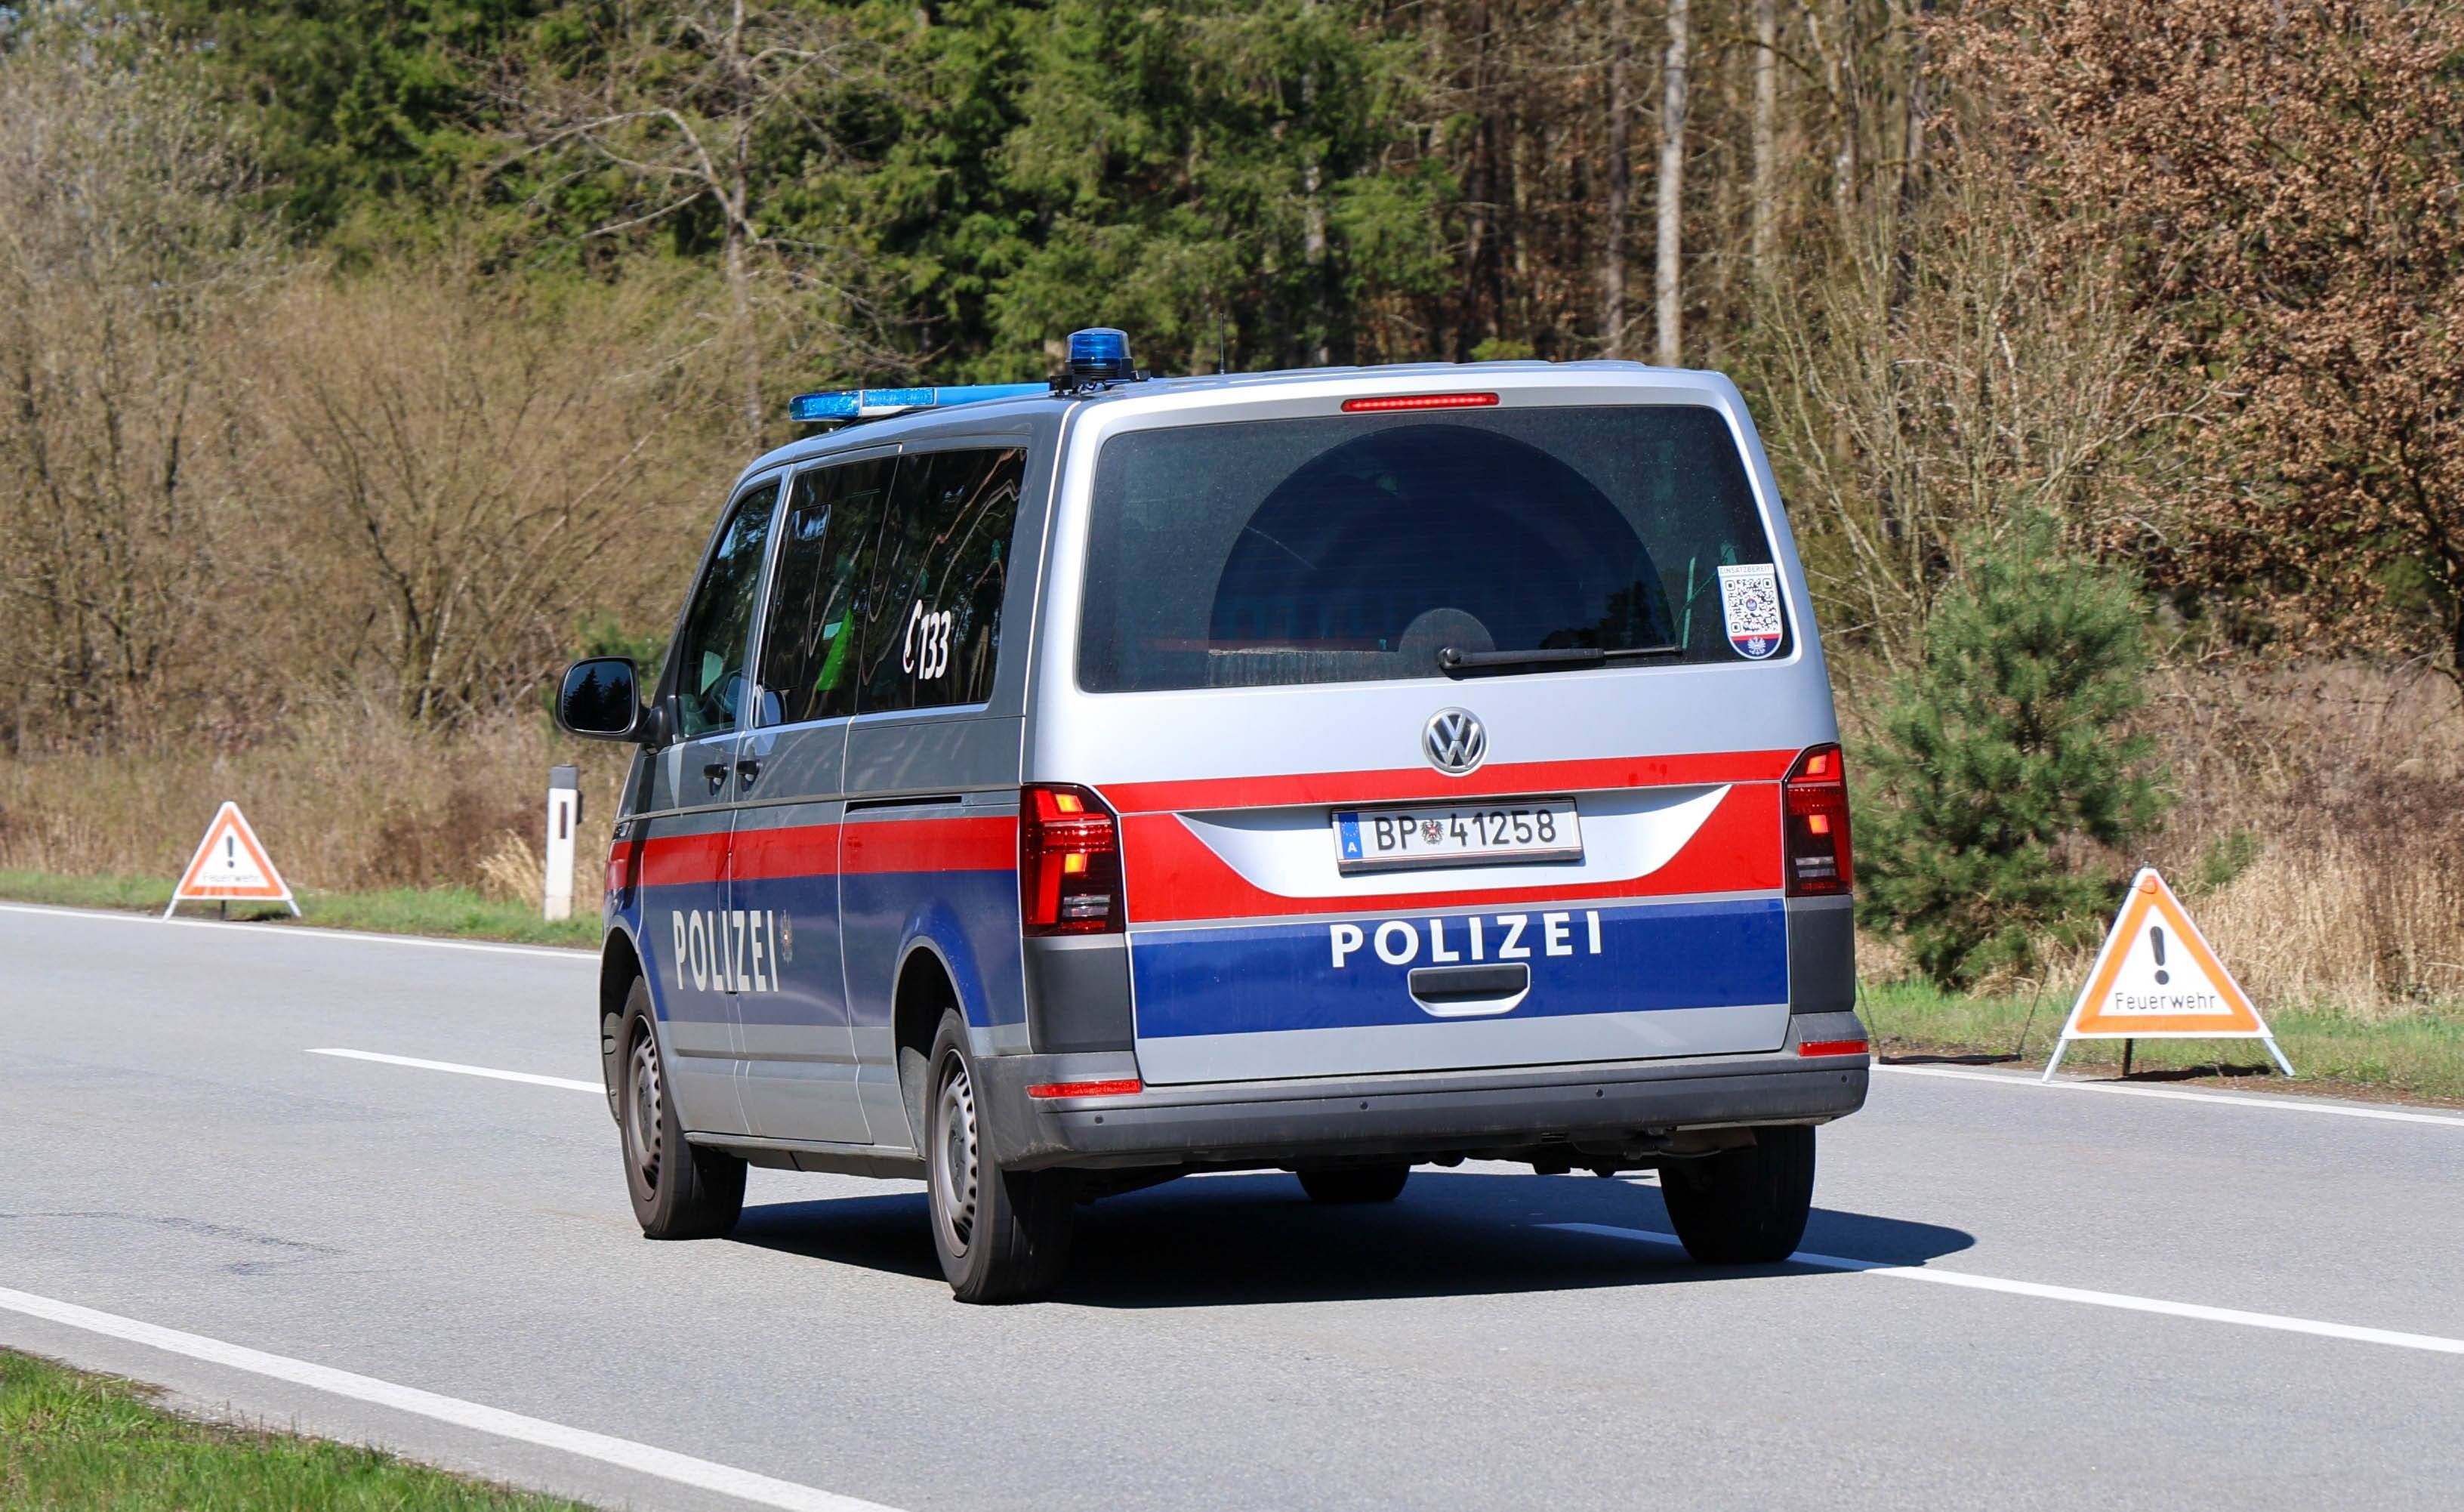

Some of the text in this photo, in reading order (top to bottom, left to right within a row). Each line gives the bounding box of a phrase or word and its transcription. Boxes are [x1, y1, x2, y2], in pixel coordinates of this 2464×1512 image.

[918, 609, 951, 680] 133
[1426, 710, 1485, 772] VW
[1347, 841, 1358, 853] A
[1374, 809, 1556, 850] BP 41258
[672, 909, 779, 992] POLIZEI
[1329, 910, 1602, 968] POLIZEI
[2114, 992, 2216, 1011] Feuerwehr
